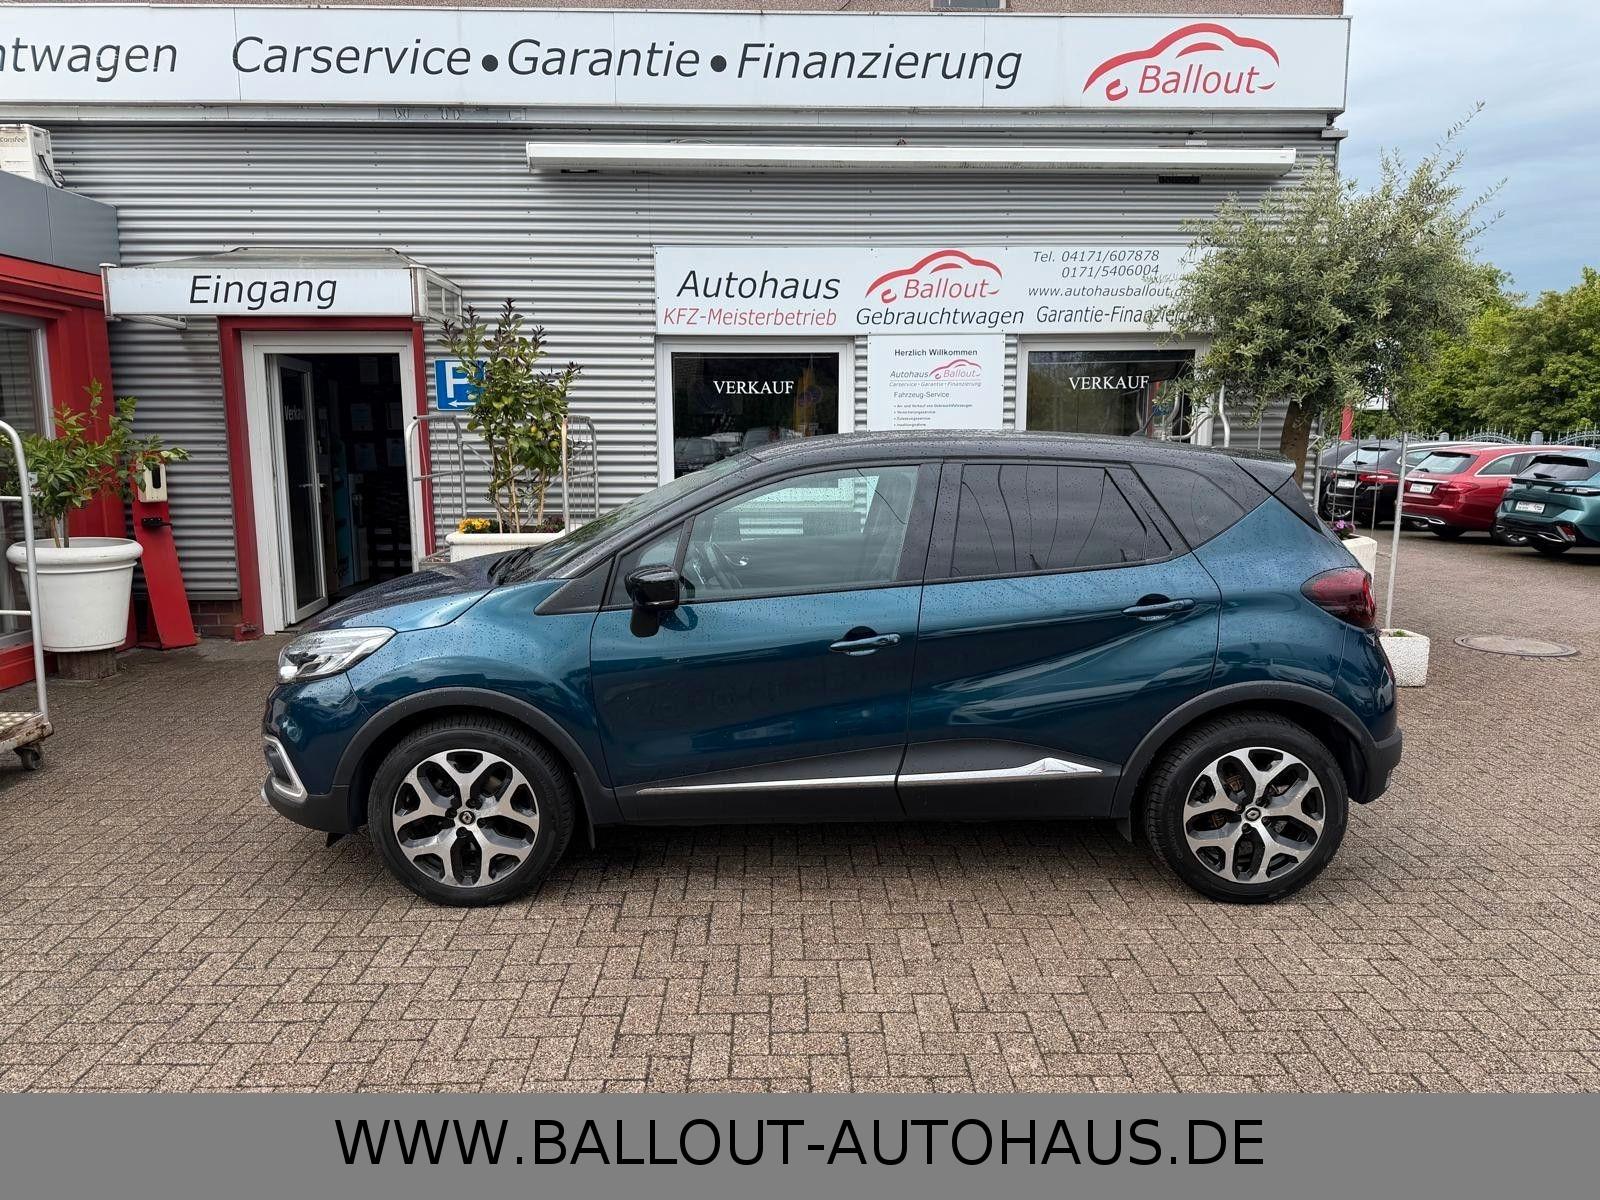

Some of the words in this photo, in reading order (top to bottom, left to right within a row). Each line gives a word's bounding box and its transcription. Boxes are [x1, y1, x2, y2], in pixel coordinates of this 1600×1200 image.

[0, 37, 177, 82] twagen
[233, 36, 471, 76] Carservice
[508, 39, 700, 78] Garantie
[737, 43, 1022, 89] Finanzierung
[1138, 64, 1258, 94] Ballout
[1033, 251, 1055, 263] Tel.
[1061, 250, 1160, 263] 04171/607878
[1061, 264, 1160, 279] 0171/5406004
[190, 275, 337, 311] Eingang
[676, 270, 841, 300] Autohaus
[904, 278, 987, 298] Ballout
[1028, 283, 1191, 297] www.autohausballout.d
[664, 308, 837, 326] KFZ-Meisterbetrieb
[856, 307, 1024, 329] Gebrauchtwagen
[1036, 306, 1200, 324] Garantie-Finanzier
[894, 348, 927, 357] Herzlich
[928, 348, 978, 357] Willkommen
[890, 370, 929, 378] Autohaus
[943, 369, 976, 378] Ballout
[713, 380, 795, 394] VERKAUF
[1069, 376, 1150, 390] VERKAUF
